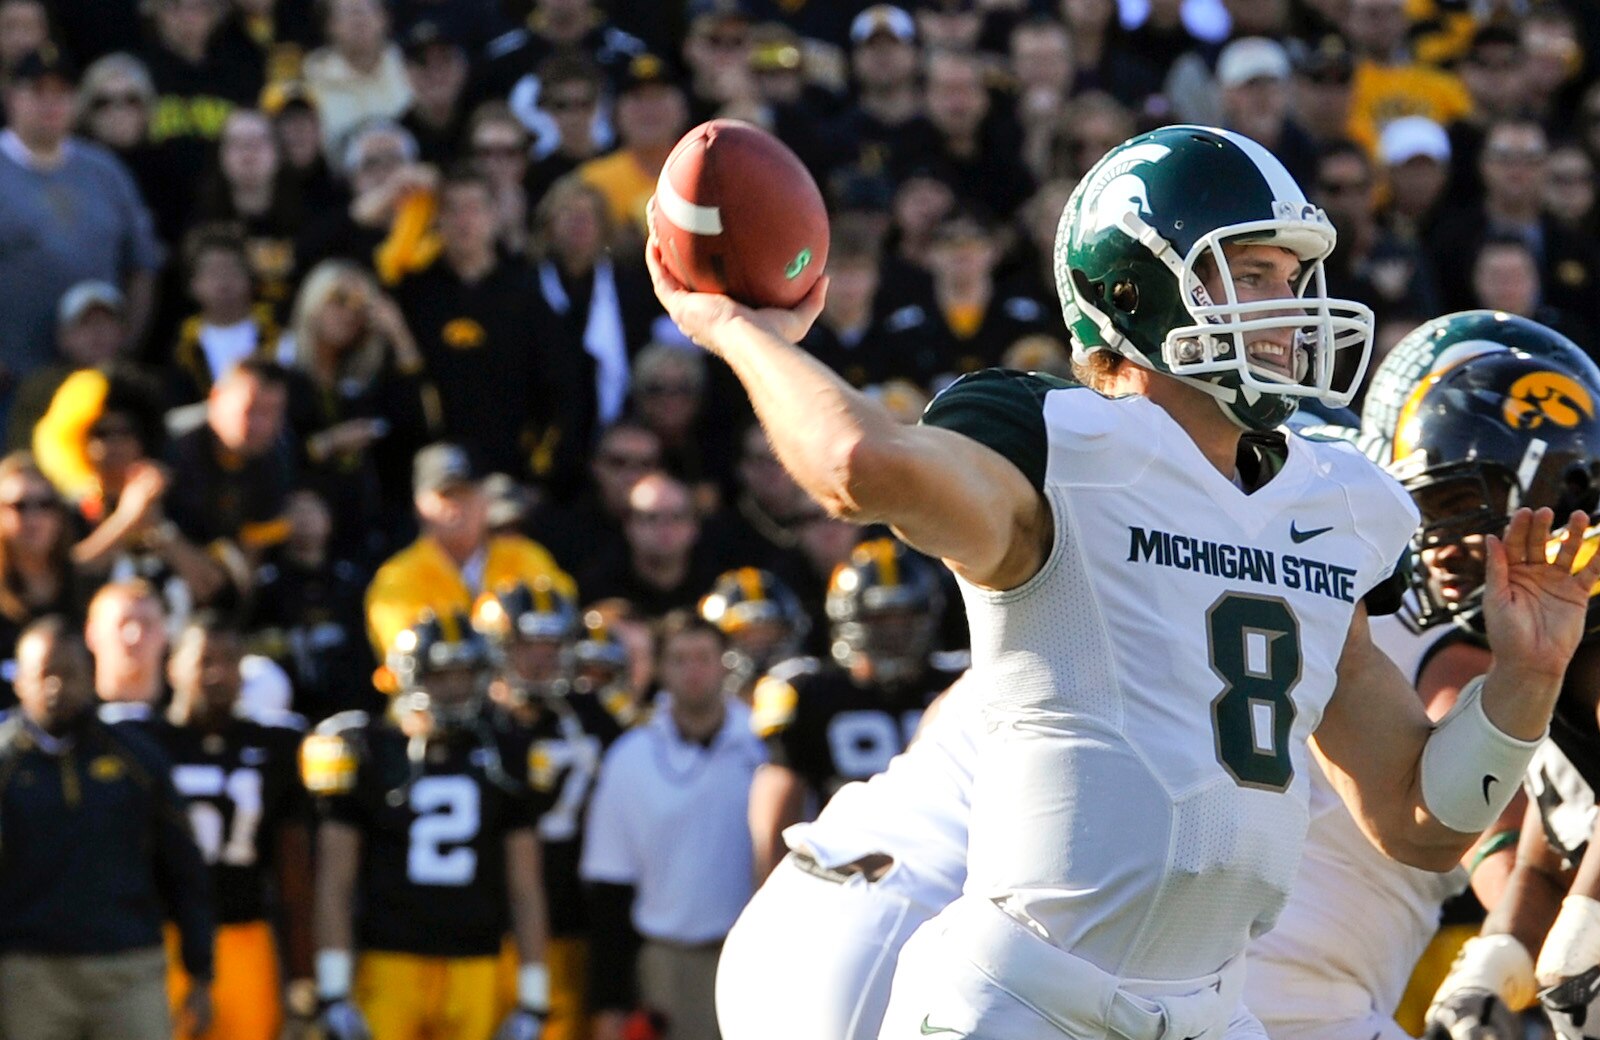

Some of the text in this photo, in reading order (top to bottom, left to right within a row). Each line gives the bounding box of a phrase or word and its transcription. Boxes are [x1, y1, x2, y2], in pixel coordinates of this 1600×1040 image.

[1127, 526, 1358, 604] MICHIGAN STATE
[1205, 589, 1303, 794] 8
[406, 773, 482, 887] 2
